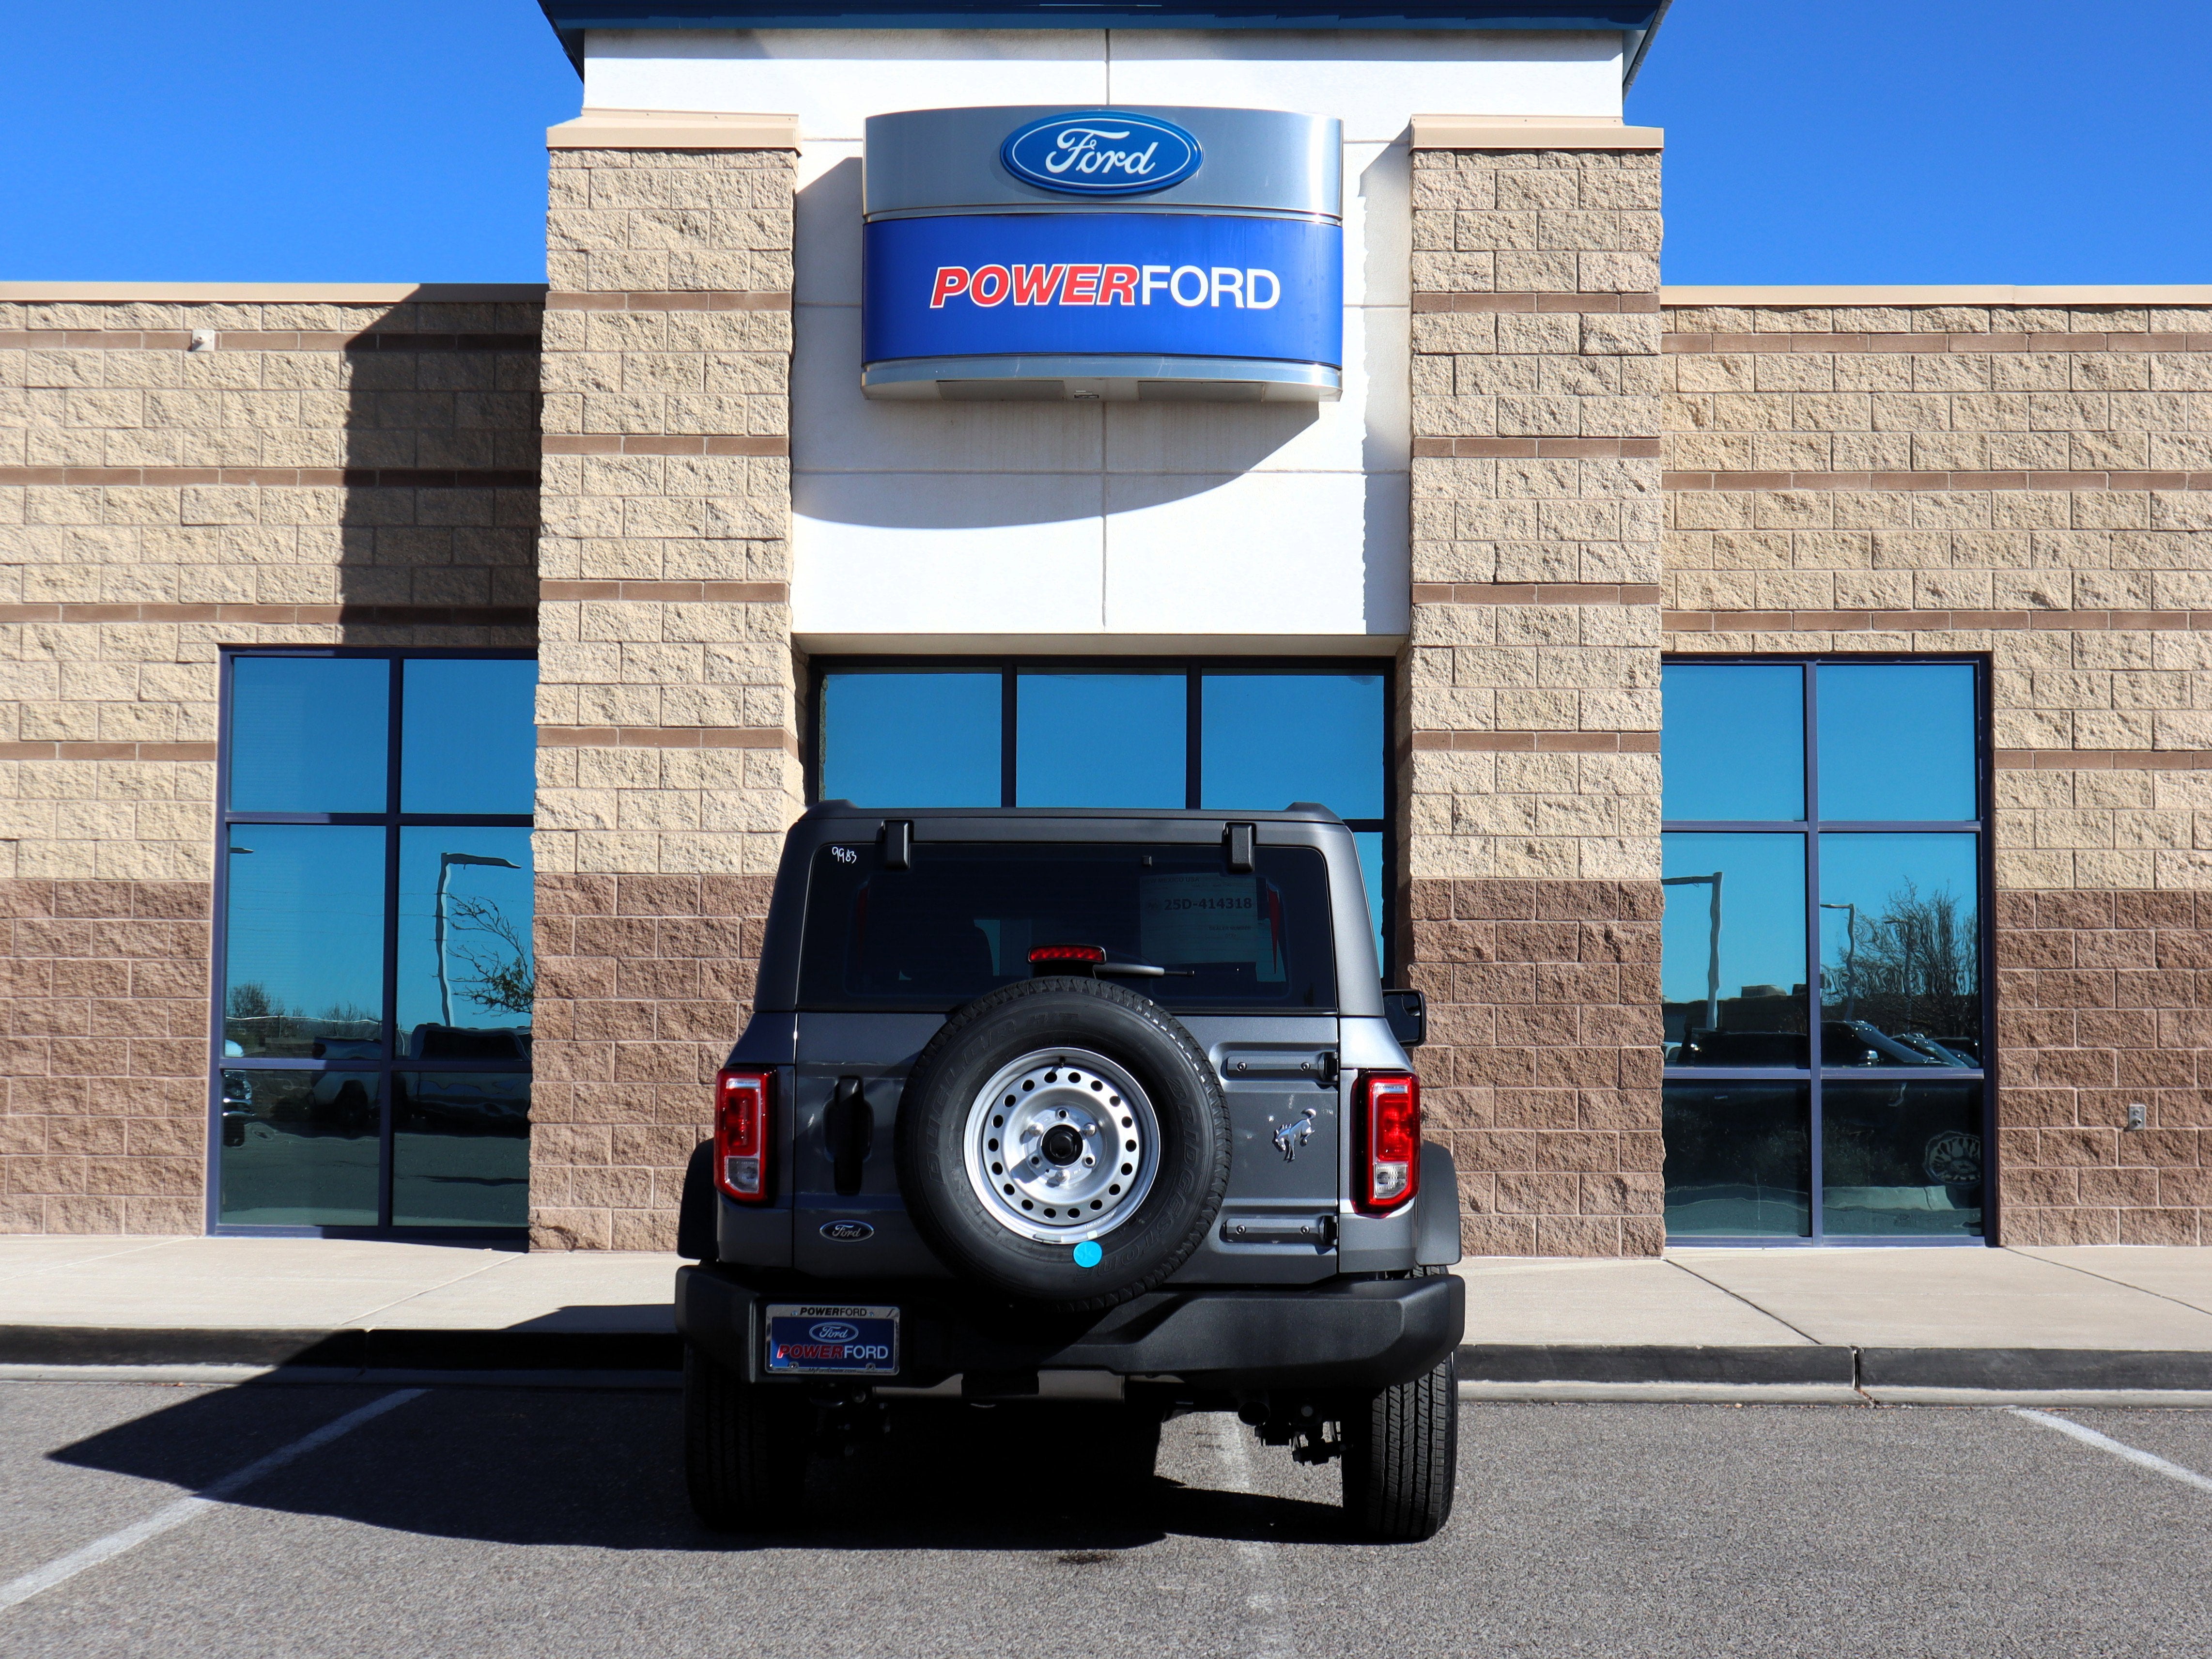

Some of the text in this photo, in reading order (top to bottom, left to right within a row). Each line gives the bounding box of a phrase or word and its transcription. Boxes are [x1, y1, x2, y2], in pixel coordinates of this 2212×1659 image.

[1045, 128, 1157, 176] Ford
[929, 263, 1281, 310] POWERFORD
[832, 846, 857, 864] 9983
[1164, 898, 1253, 911] 25D-414318
[1074, 1075, 1200, 1282] BRIDGESTONE
[832, 1225, 861, 1238] Ford
[800, 1307, 867, 1317] POWERFORD
[819, 1326, 848, 1339] Ford
[776, 1344, 889, 1360] POWERFORD
